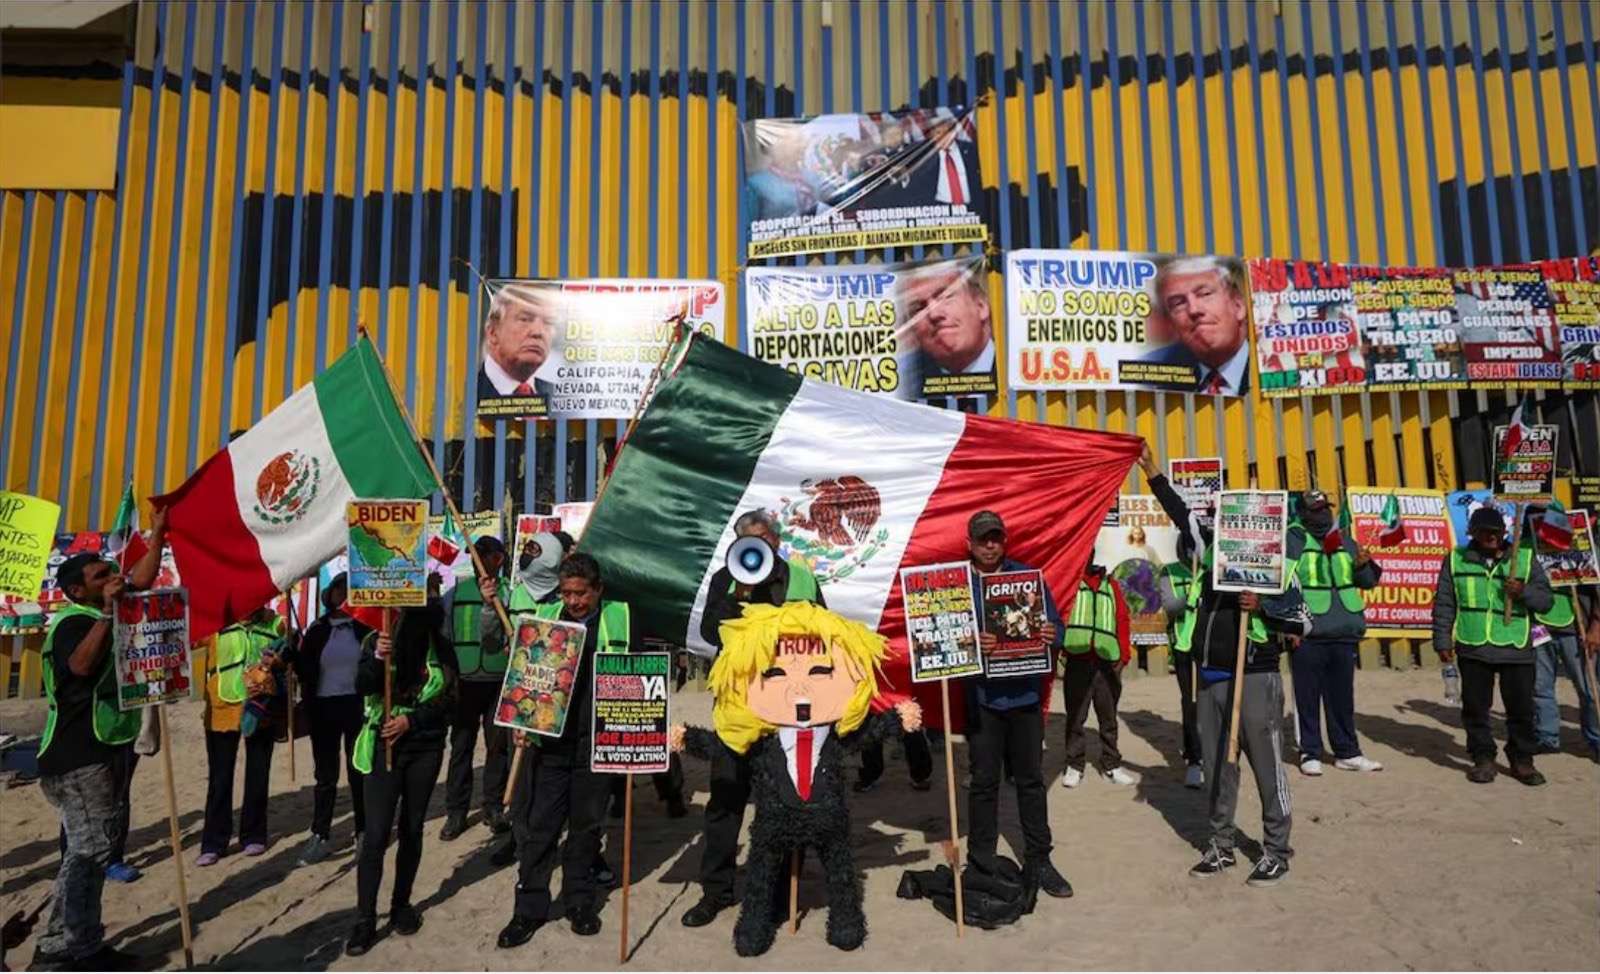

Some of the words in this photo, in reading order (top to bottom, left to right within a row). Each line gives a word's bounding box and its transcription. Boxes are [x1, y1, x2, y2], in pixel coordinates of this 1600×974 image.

[856, 205, 950, 222] SUBORDINACION
[753, 241, 790, 256] ANGELES
[791, 239, 807, 251] SIN
[808, 235, 858, 250] FRONTERAS
[866, 230, 901, 245] ALIANZA
[902, 227, 947, 242] MIGRANTE
[948, 226, 983, 241] TIJUANA
[1015, 259, 1154, 287] TRUMP
[1250, 258, 1288, 292] NO
[1294, 259, 1313, 289] A
[1317, 260, 1350, 288] LA
[1376, 278, 1453, 294] QUEREMOS
[1487, 284, 1516, 297] LOS
[1020, 290, 1056, 316] NO
[1063, 290, 1151, 317] SOMOS
[1253, 288, 1351, 306] INTROMISION
[1355, 292, 1405, 311] SEGUIR
[1408, 293, 1456, 309] SIENDO
[1293, 305, 1319, 319] DE
[1477, 300, 1533, 313] PERROS
[754, 302, 819, 333] ALTO
[824, 300, 843, 329] A
[847, 299, 897, 328] LAS
[1367, 313, 1392, 328] EL
[1399, 310, 1451, 327] PATIO
[1463, 315, 1552, 328] GUARDIANES
[1027, 319, 1118, 342] ENEMIGOS
[1123, 320, 1145, 342] DE
[1265, 320, 1350, 339] ESTADOS
[1367, 329, 1457, 346] TRASERO
[1497, 330, 1525, 343] DEL
[754, 329, 898, 361] DEPORTACIONES
[1273, 336, 1350, 353] UNIDOS
[1483, 346, 1544, 360] IMPERIO
[1300, 353, 1323, 368] EN
[1405, 347, 1425, 361] DE
[557, 366, 645, 380] CALIFORNIA,
[1020, 349, 1112, 383] U.S.A.
[1373, 361, 1459, 382] EE.UU.
[1260, 366, 1367, 390] MEXICO
[555, 382, 603, 395] NEVADA,
[607, 382, 643, 396] UTAH,
[551, 398, 587, 411] NUEVO
[588, 398, 632, 412] MEXICO,
[358, 506, 417, 522] BIDEN
[1398, 495, 1444, 516] TRUMP
[0, 567, 36, 591] ALES
[1402, 572, 1434, 585] PARTES
[353, 590, 386, 600] ALTO
[985, 580, 1038, 600] ¡GRITO!
[1363, 586, 1437, 605] MUND
[935, 612, 970, 627] PATIO
[1378, 607, 1389, 620] TE
[145, 633, 164, 643] DE
[915, 625, 972, 643] TRASERO
[129, 655, 180, 672] UNIDOS
[920, 650, 974, 669] EE.UU.
[641, 676, 667, 700] YA
[604, 724, 641, 732] PROMETIDA
[641, 724, 657, 732] POR
[595, 732, 620, 746] JOE
[622, 732, 668, 746] BIDEN
[594, 752, 607, 762] AL
[607, 752, 632, 763] VOTO
[632, 752, 667, 763] LATINO
[635, 745, 665, 753] GRACIAS
